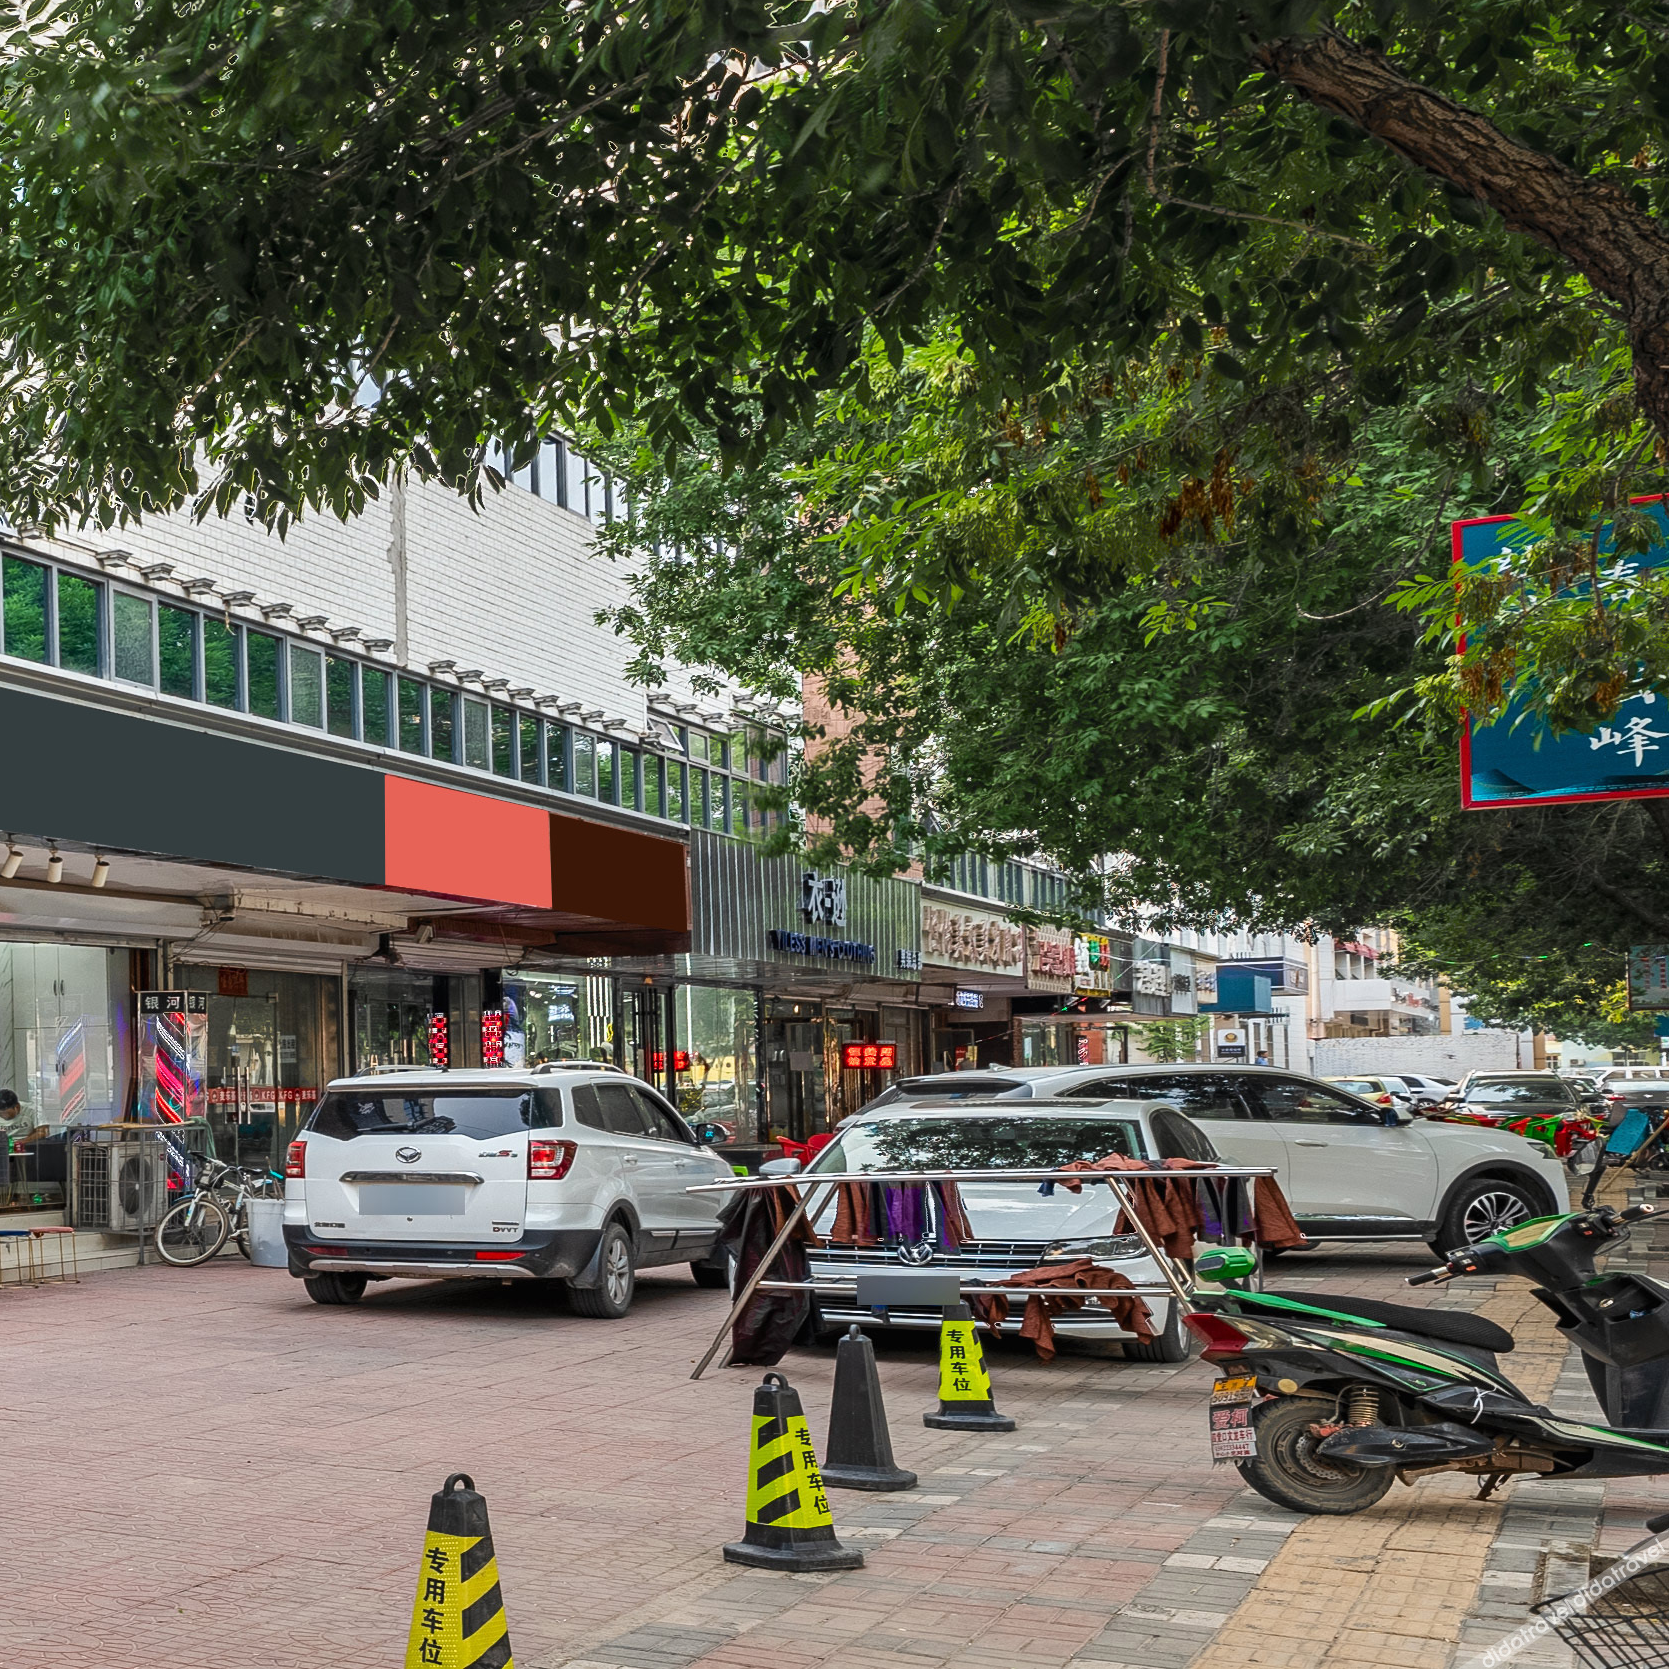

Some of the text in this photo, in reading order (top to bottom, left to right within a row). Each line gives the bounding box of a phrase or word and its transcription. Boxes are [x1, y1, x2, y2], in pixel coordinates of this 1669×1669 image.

[145, 996, 180, 1010] 银河
[946, 1328, 972, 1393] 专用车位
[794, 1426, 831, 1516] 专用车位
[419, 1545, 450, 1667] 专用车位
